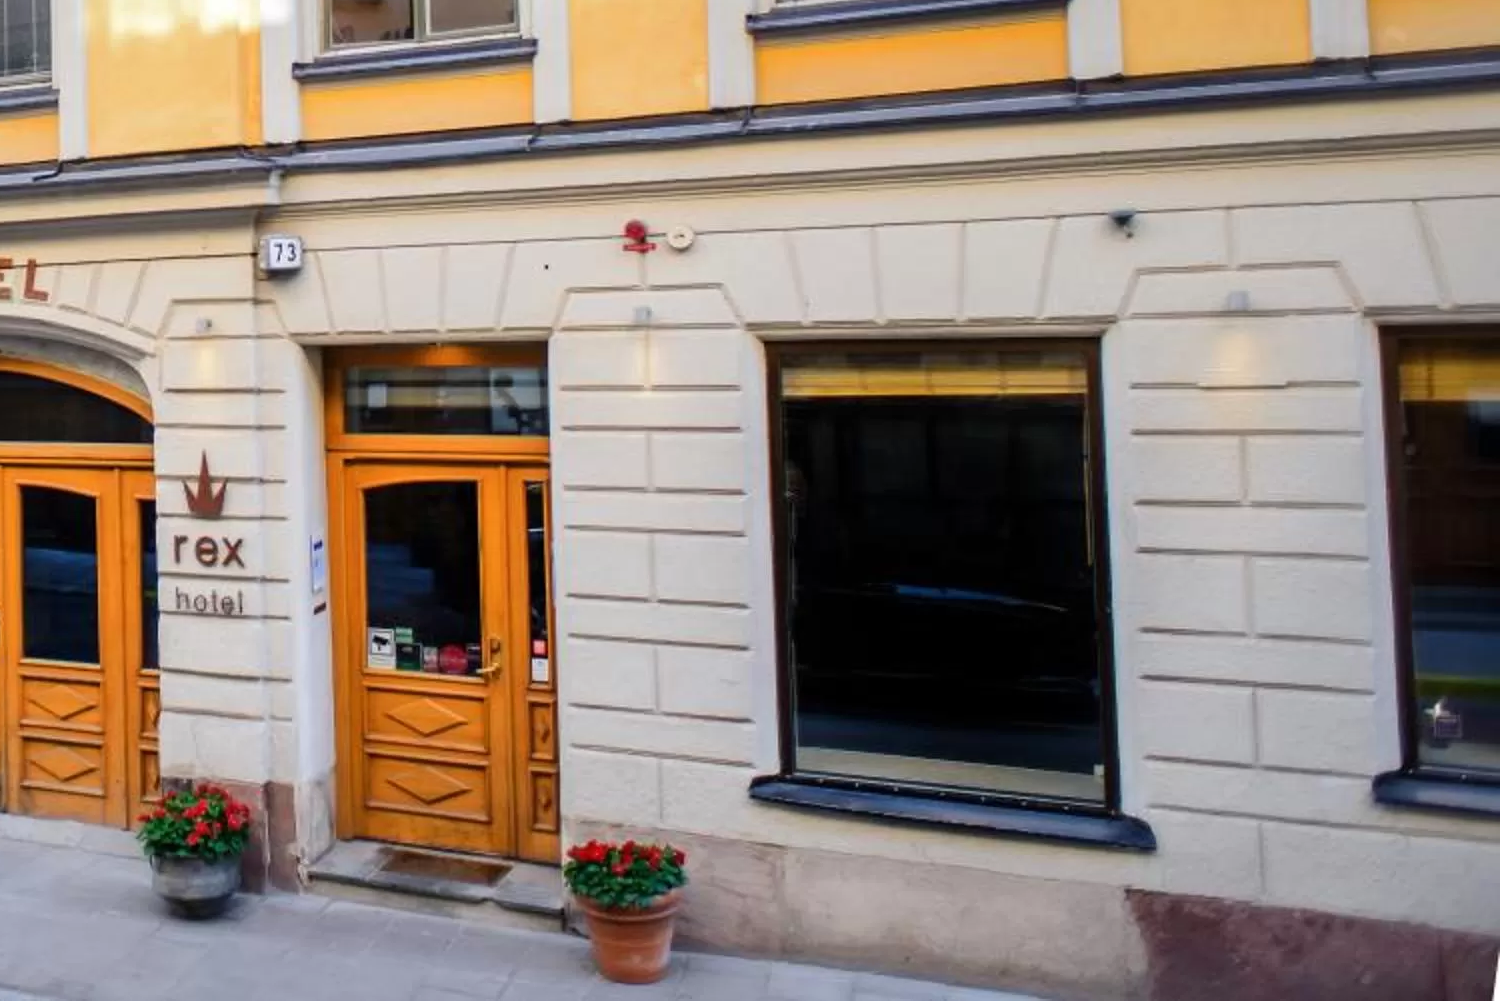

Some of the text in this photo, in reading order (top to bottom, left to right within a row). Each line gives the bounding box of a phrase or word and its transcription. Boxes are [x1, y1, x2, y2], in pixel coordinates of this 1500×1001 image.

[273, 242, 297, 263] 73
[173, 535, 245, 568] rex
[175, 587, 244, 616] hotel
